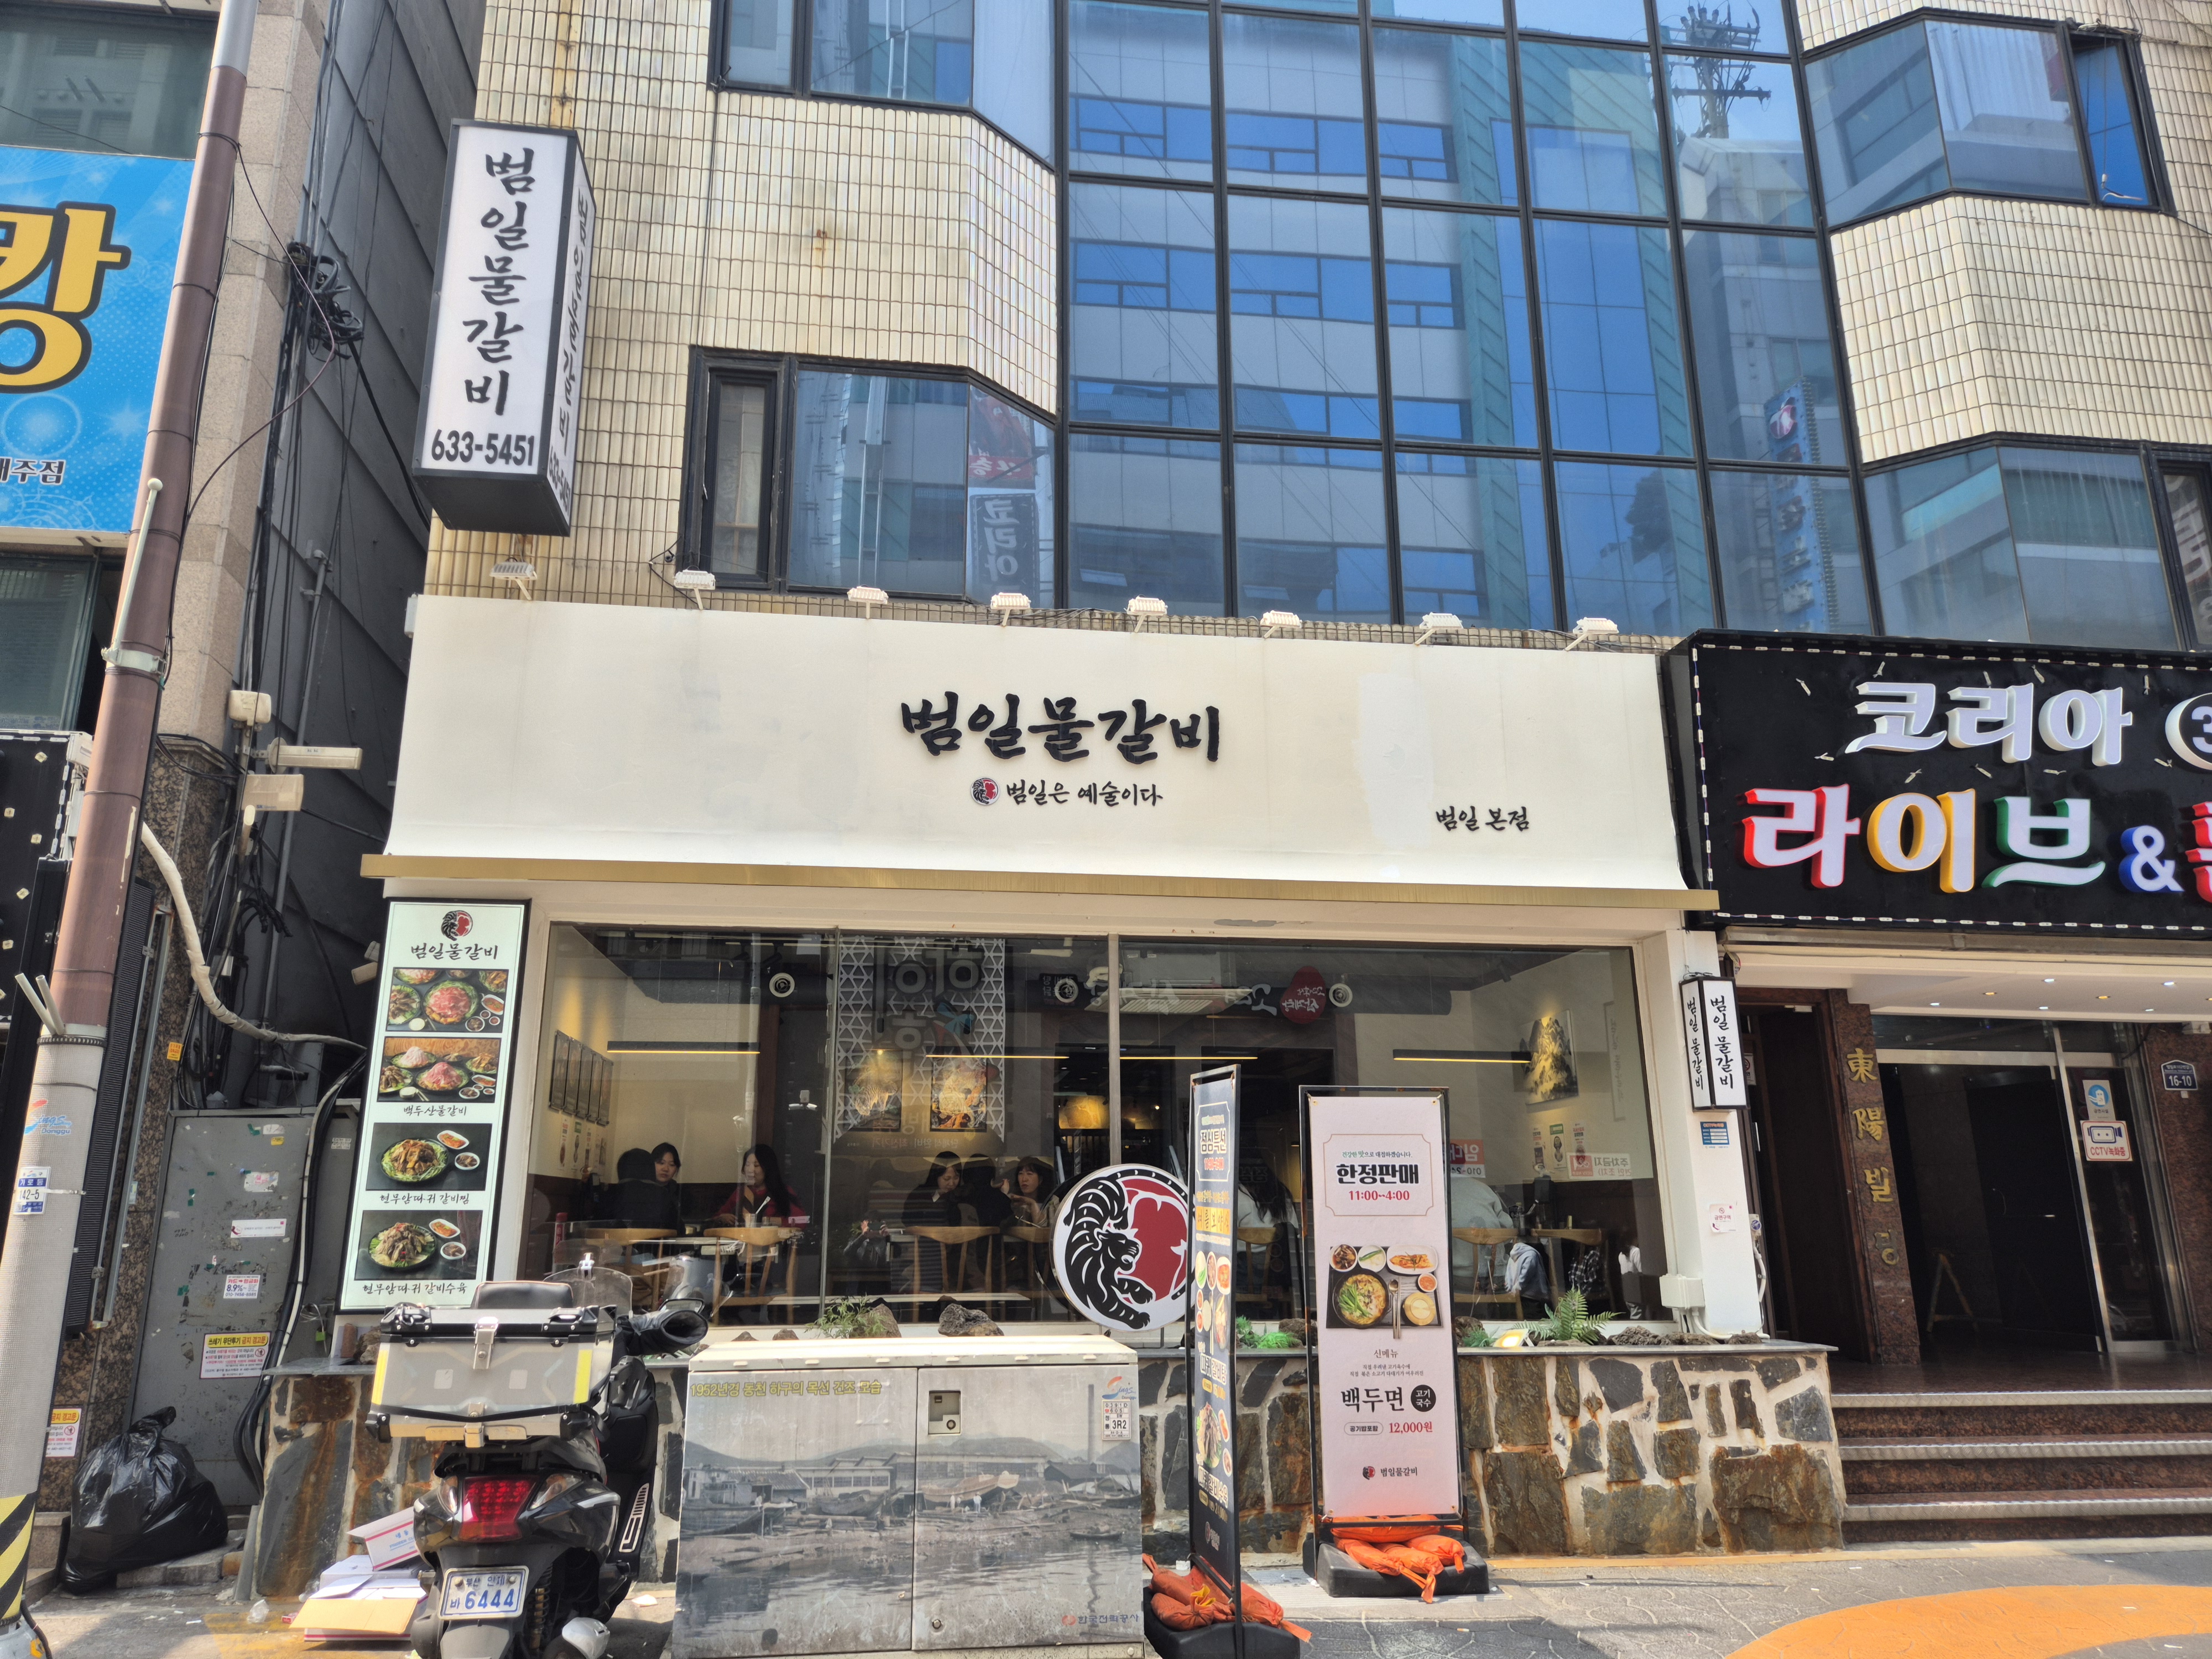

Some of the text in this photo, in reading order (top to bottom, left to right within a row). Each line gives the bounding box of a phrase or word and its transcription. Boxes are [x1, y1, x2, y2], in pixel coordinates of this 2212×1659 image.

[462, 148, 535, 416] 범일물갈비
[431, 429, 535, 466] 633-5451
[901, 691, 1219, 765] 범일물갈비
[1845, 682, 2133, 766] 코리아
[1006, 779, 1164, 807] 범일은 예술이다
[1436, 805, 1530, 832] 범일 본점
[1741, 783, 2106, 894] 라이브
[411, 943, 498, 961] 범일물갈비
[1687, 997, 1704, 1091] 범일 물갈비
[1710, 995, 1734, 1089] 범일 물갈비
[2168, 1075, 2192, 1087] 16-10
[404, 1105, 467, 1117] 백두산물갈비
[1201, 1128, 1227, 1154] 점심특선
[2090, 1146, 2126, 1157] CCTV녹화중
[1336, 1164, 1420, 1185] 한정판매
[19, 1189, 40, 1200] 142-5
[1348, 1190, 1410, 1201] 11:00~4:00
[1374, 1349, 1399, 1359] 신메뉴
[691, 1379, 882, 1397] 1952년경 동천 하구의 목선 건조 모습
[1415, 1389, 1431, 1398] 고기
[1340, 1386, 1405, 1413] 백두면
[1415, 1399, 1431, 1408] 국수
[62, 1412, 76, 1421] 경고문
[1112, 1420, 1126, 1430] 3R2
[1389, 1421, 1433, 1434] 12,000원
[1380, 1467, 1418, 1477] 범일물갈비
[466, 1577, 481, 1587] 부산
[450, 1588, 515, 1609] 바 6444
[1078, 1614, 1139, 1624] 한국전력공사
